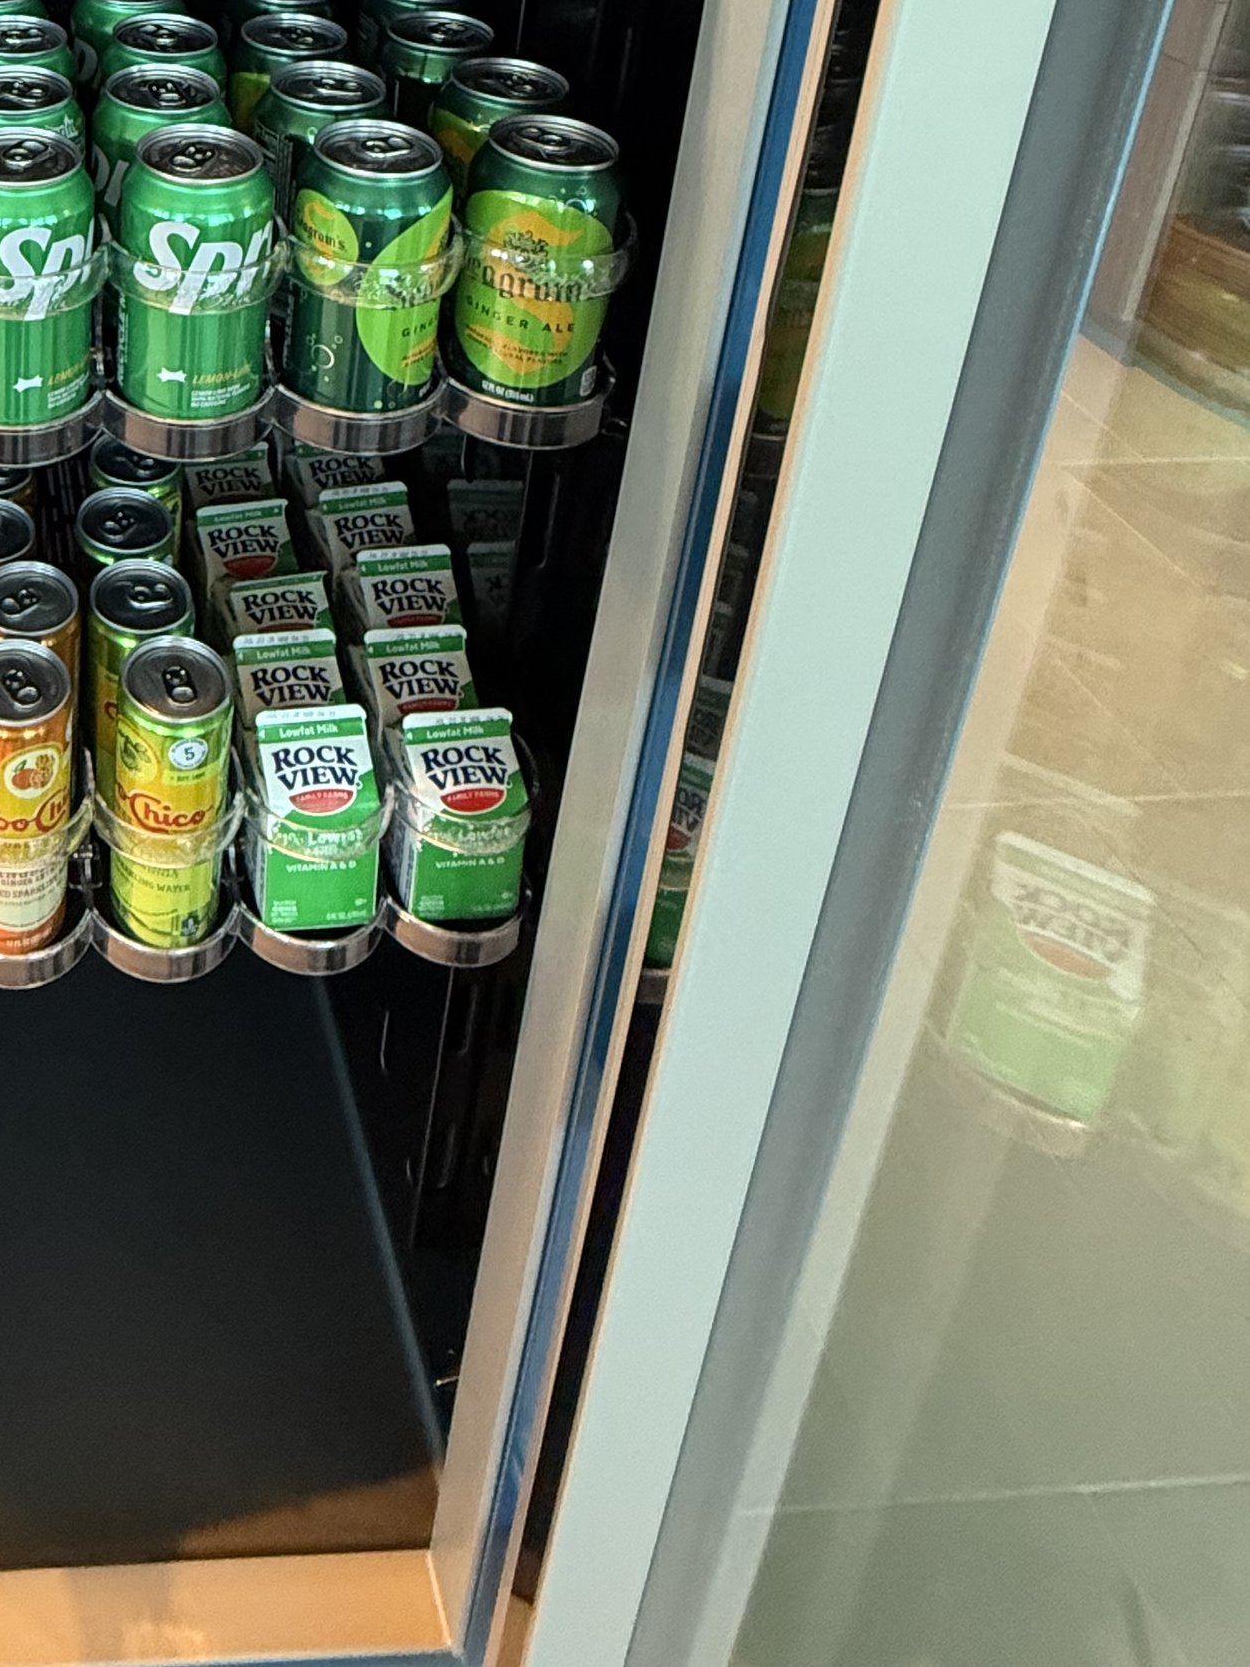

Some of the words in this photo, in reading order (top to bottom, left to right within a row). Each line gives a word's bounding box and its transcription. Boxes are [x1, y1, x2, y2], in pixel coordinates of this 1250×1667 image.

[466, 295, 529, 330] GINGER
[542, 322, 575, 334] ALE
[194, 466, 260, 484] ROCK
[200, 479, 262, 496] VIEW
[334, 513, 401, 536] ROCK
[208, 525, 278, 549] ROCK
[340, 532, 403, 553] VIEW
[213, 539, 279, 560] VIEW
[377, 562, 411, 574] Lowfat
[372, 577, 444, 603] ROCK
[242, 589, 318, 613] ROCK
[376, 595, 448, 618] VIEW
[249, 606, 319, 626] VIEW
[256, 646, 290, 661] Lowfat
[292, 644, 311, 656] Milk
[385, 642, 420, 655] Lowfat
[420, 640, 441, 652] Milk
[250, 665, 333, 695] ROCK
[378, 659, 457, 686] ROCK
[255, 684, 333, 707] VIEW
[386, 679, 462, 701] VIEW
[279, 723, 315, 739] Lowfat
[316, 722, 339, 735] Milk
[426, 725, 461, 740] Lowfat
[462, 724, 485, 737] Milk
[183, 746, 196, 761] 5
[271, 745, 358, 775] ROCK
[420, 745, 507, 774] ROCK
[427, 764, 508, 791] VIEW
[447, 791, 473, 803] FAMILY
[474, 790, 501, 800] FARMS
[128, 791, 214, 835] Chico
[286, 862, 329, 873] VITAMIN
[329, 861, 338, 870] A
[435, 858, 477, 869] VITAMIN
[478, 857, 486, 866] A
[487, 857, 496, 865] &
[497, 856, 506, 865] D
